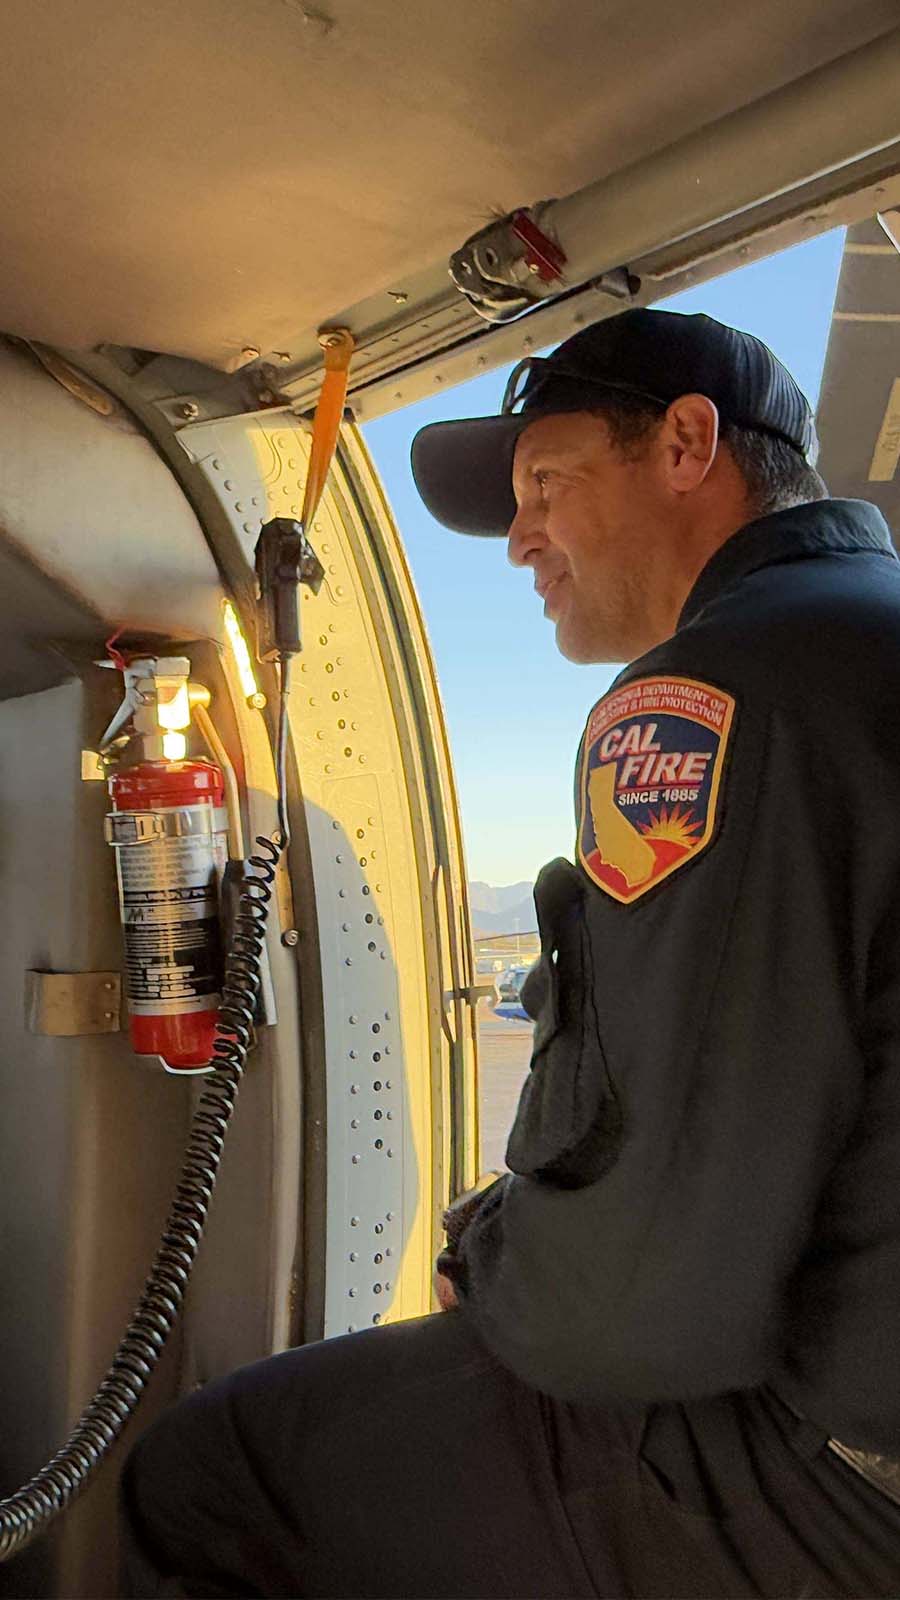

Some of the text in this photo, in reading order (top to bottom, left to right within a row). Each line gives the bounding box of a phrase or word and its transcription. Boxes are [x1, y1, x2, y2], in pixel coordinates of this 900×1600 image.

[600, 723, 661, 761] CAL
[617, 752, 712, 789] FIRE
[618, 788, 698, 806] SINCE 1885
